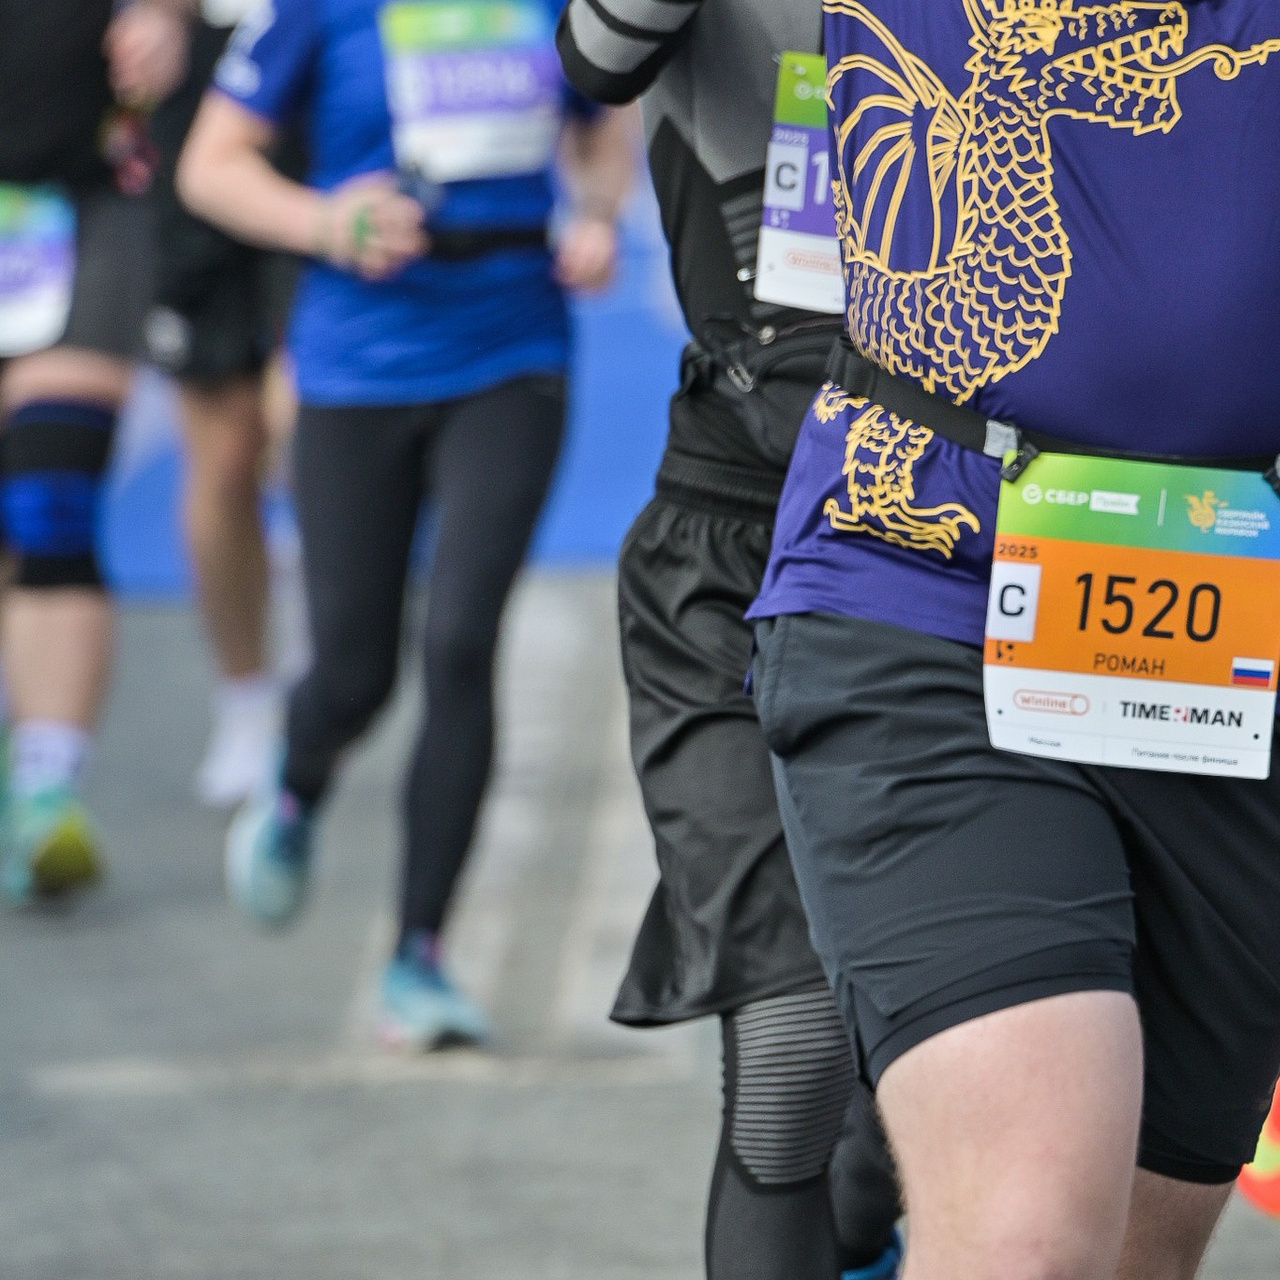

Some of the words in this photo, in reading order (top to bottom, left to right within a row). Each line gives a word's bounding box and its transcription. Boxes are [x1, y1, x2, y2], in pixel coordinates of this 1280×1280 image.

[775, 162, 797, 191] C
[998, 544, 1039, 558] 2025
[1000, 584, 1025, 616] C
[1076, 572, 1222, 642] 1520
[1093, 652, 1165, 675] РОМАН
